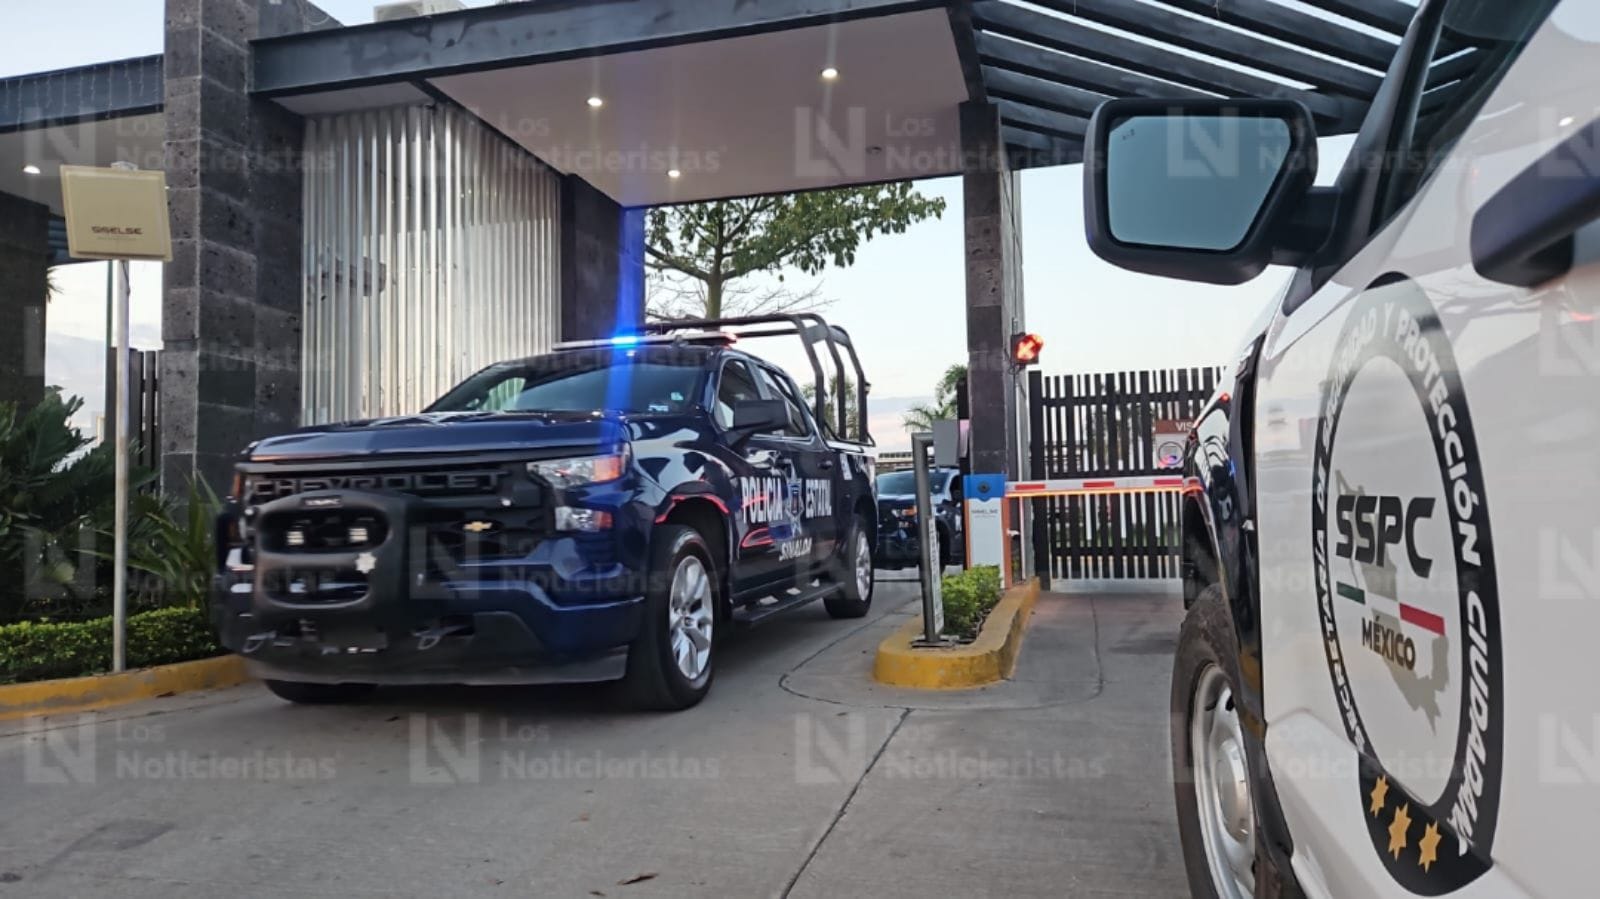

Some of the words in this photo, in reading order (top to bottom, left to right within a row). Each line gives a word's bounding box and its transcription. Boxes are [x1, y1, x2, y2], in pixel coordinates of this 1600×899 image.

[1383, 302, 1395, 337] Y
[1395, 307, 1483, 567] PROTECCIÓN
[253, 470, 511, 497] CHEVROLET
[778, 537, 813, 562] SINALOA
[1335, 493, 1437, 580] SSPC
[1361, 614, 1417, 672] MÉXICO
